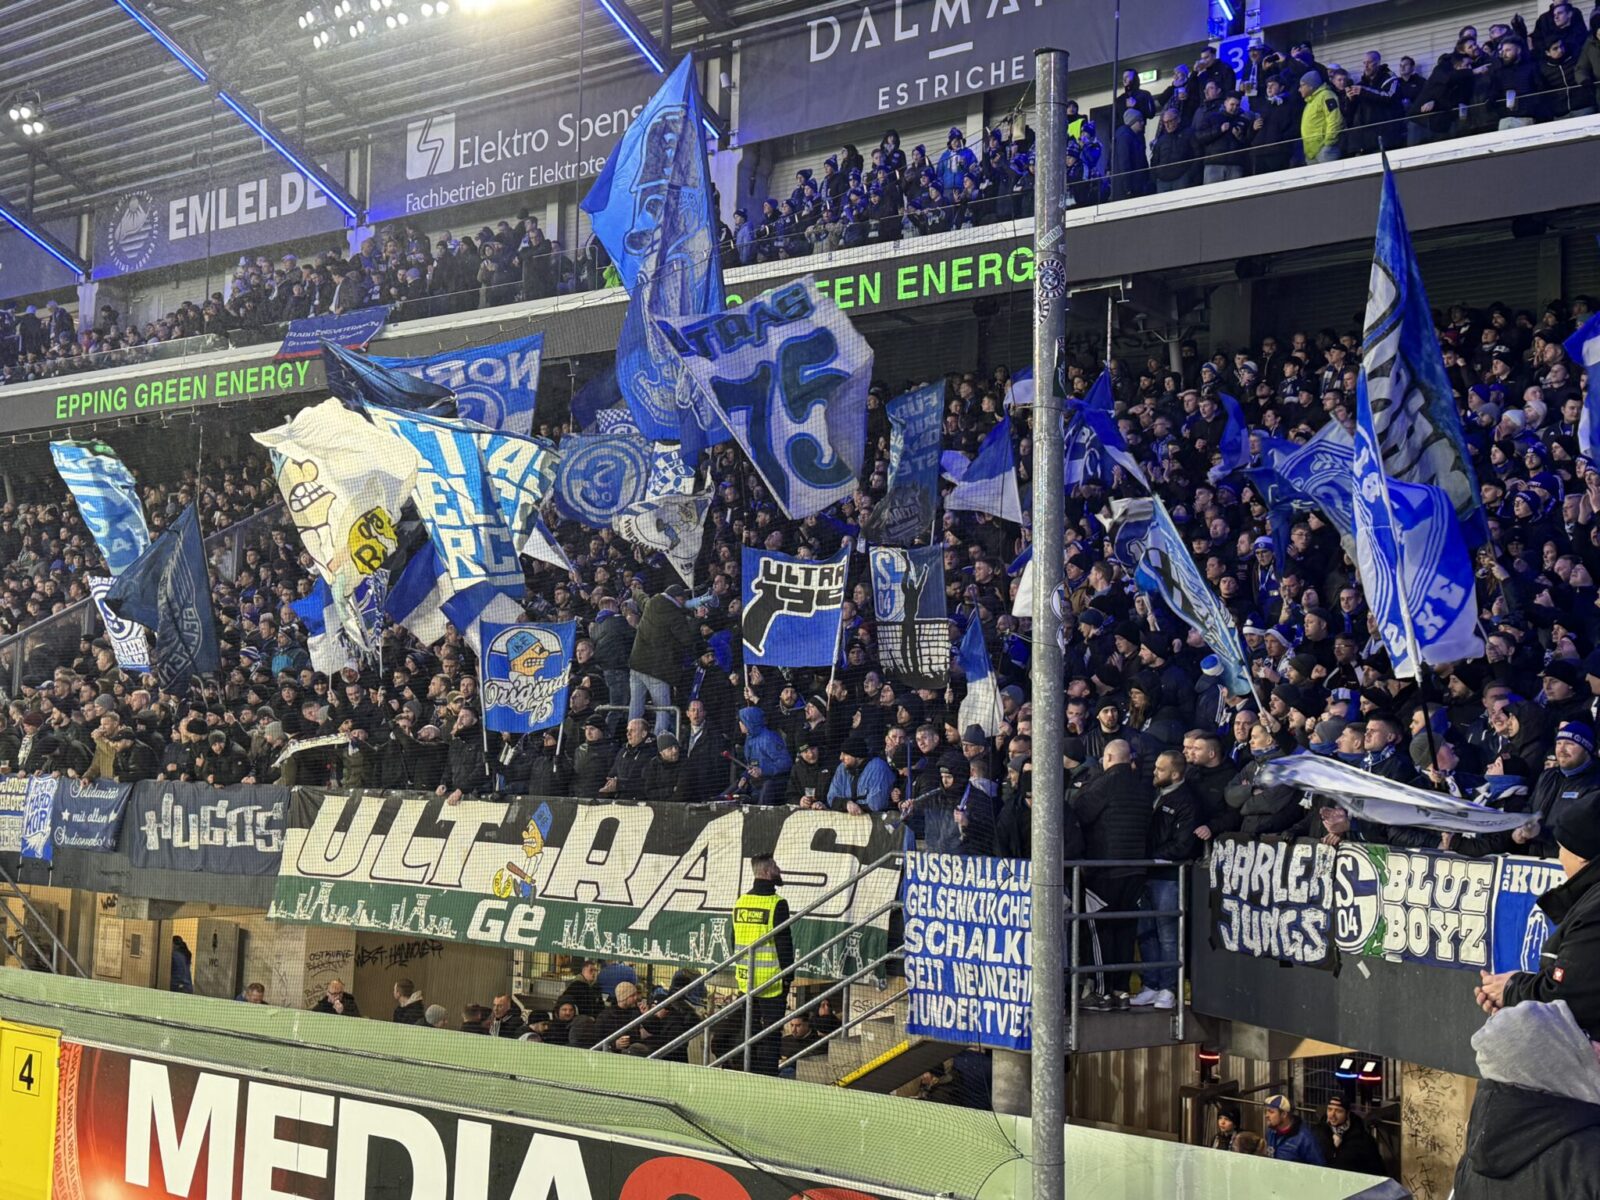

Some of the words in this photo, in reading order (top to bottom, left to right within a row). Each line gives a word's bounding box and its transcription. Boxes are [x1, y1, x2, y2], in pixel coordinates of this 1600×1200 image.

[877, 55, 1025, 110] ESTRICHE
[458, 128, 549, 169] Elektro
[405, 180, 496, 212] Fachbetrieb
[501, 168, 524, 192] für
[56, 387, 127, 420] EPPING
[134, 375, 207, 407] GREEN
[214, 360, 310, 397] ENERGY
[72, 810, 87, 822] mit
[88, 807, 107, 823] allen
[140, 793, 283, 852] HUGOS
[296, 794, 873, 931] ULTRAS
[906, 851, 1032, 893] FUSSBALLCLU
[1209, 839, 1336, 910] MARLER
[1382, 852, 1495, 914] BLUE
[466, 898, 547, 946] Ge
[907, 883, 1032, 929] GELSENKIRCHE
[1220, 898, 1327, 962] JUNGS
[1381, 902, 1488, 966] BOYZ
[209, 957, 219, 967] WC
[904, 955, 944, 992] SEIT
[19, 1053, 34, 1091] 4
